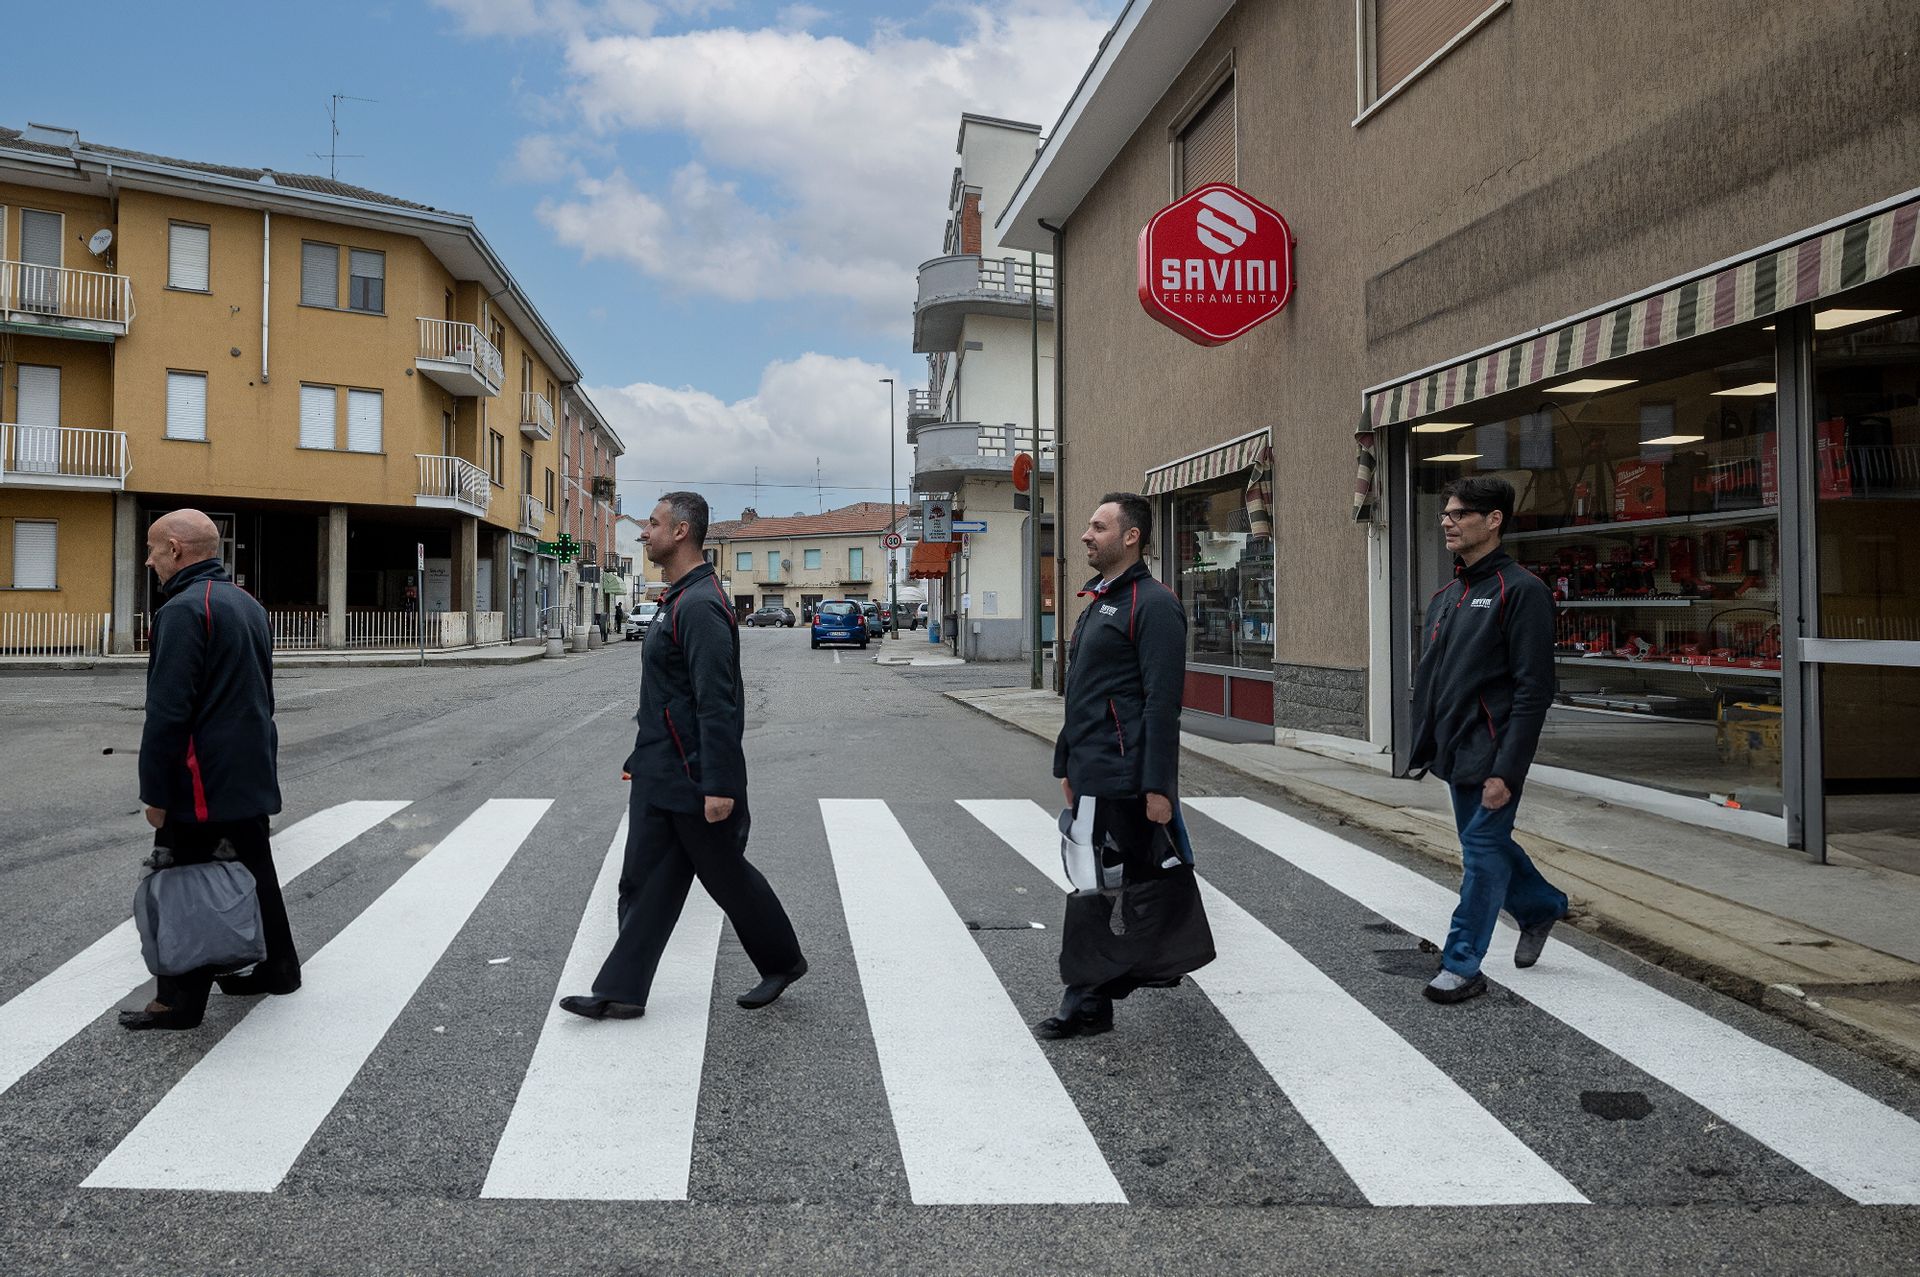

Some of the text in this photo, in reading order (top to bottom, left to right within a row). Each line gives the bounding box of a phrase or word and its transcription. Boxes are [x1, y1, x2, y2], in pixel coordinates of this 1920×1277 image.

[1161, 258, 1277, 292] SAVINI
[1163, 293, 1278, 304] FERRAMENTA
[888, 537, 898, 545] 30
